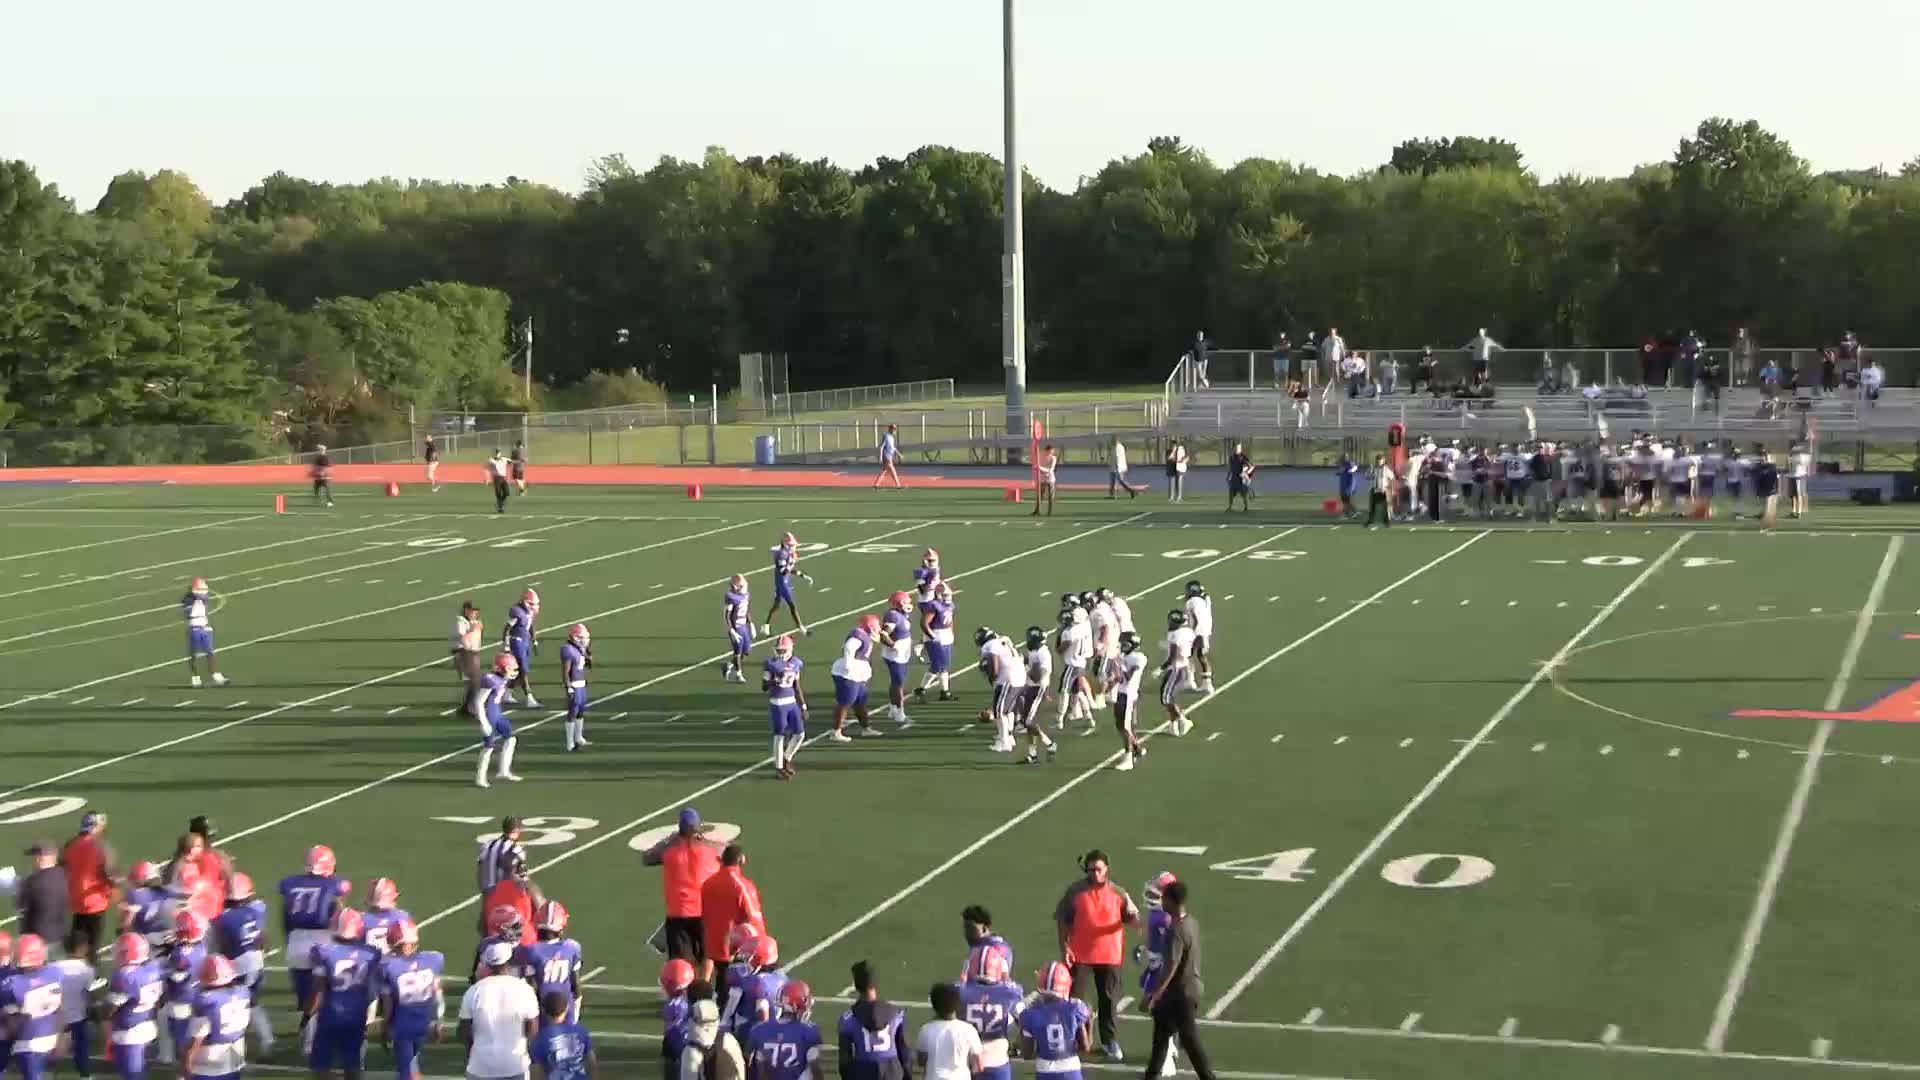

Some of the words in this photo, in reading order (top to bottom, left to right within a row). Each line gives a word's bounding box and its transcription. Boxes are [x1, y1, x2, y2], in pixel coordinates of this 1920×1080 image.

[290, 887, 321, 914] 77
[966, 1003, 1004, 1033] 52
[1046, 1023, 1065, 1051] 9
[763, 1042, 799, 1068] 72
